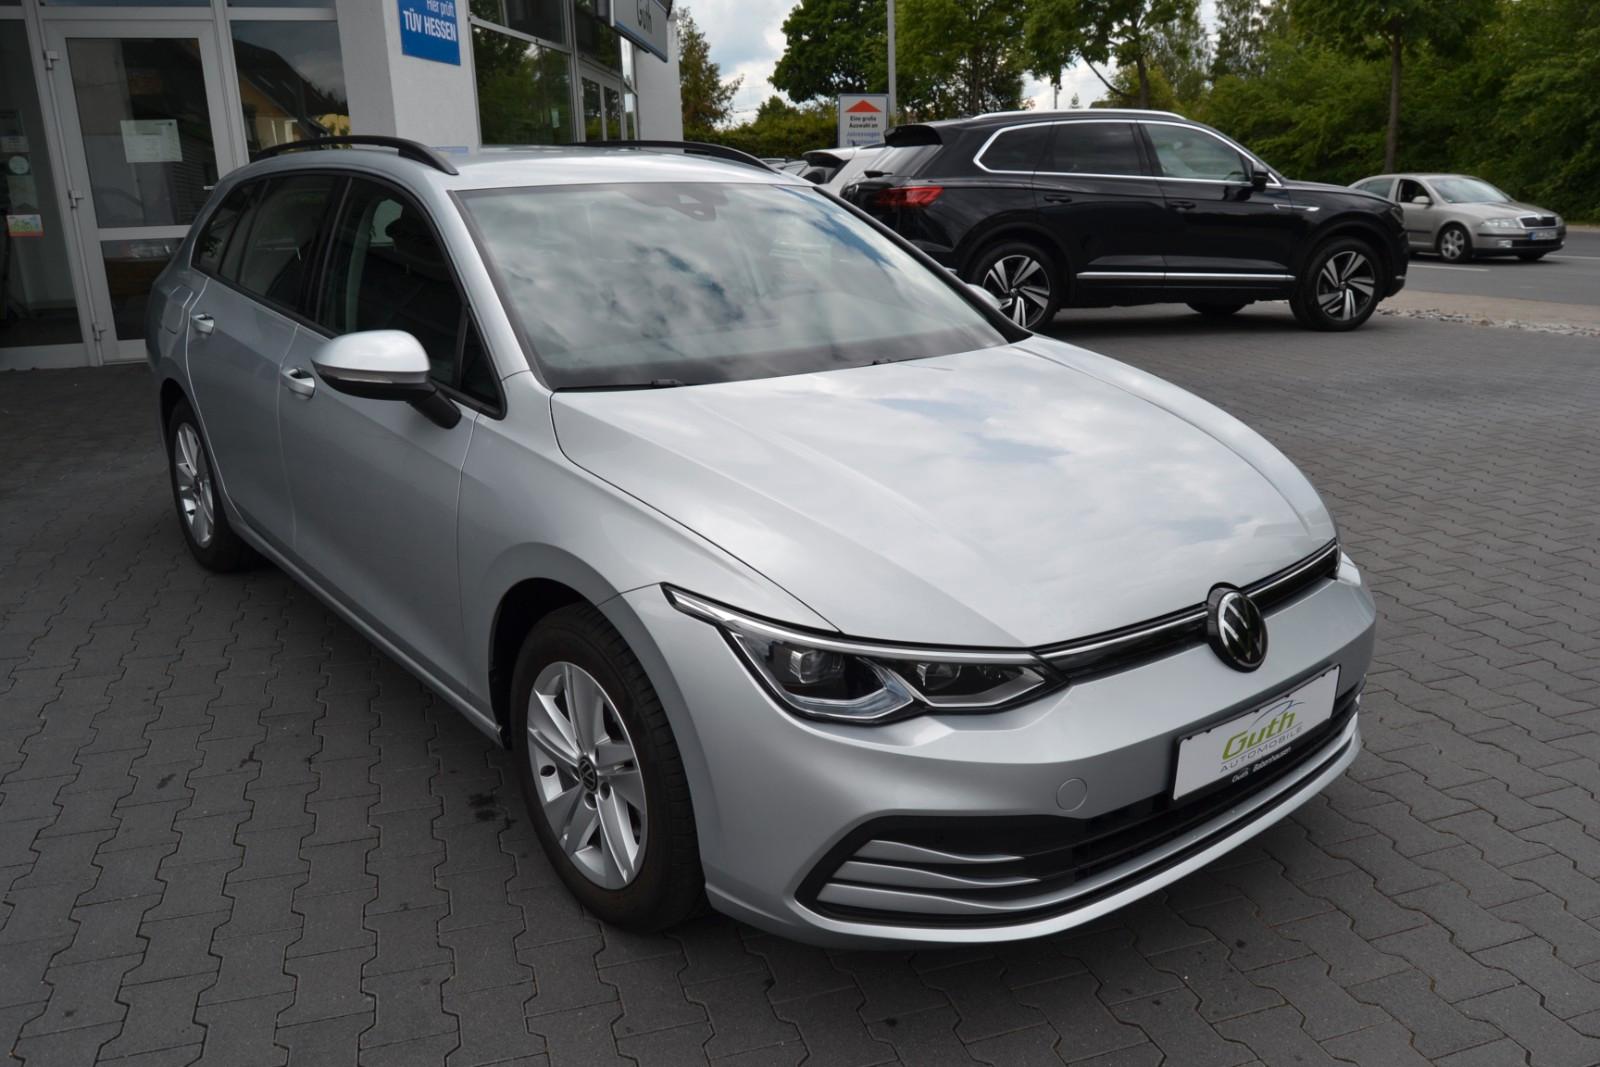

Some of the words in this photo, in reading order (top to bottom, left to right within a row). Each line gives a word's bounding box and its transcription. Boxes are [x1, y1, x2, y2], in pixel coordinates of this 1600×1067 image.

[402, 7, 422, 33] TÜV
[423, 15, 457, 42] HESSEN
[440, 1, 456, 18] prüft
[1220, 725, 1304, 773] AUTOMOBILE
[1222, 711, 1297, 760] Guth
[1252, 746, 1292, 773] Babenhausen
